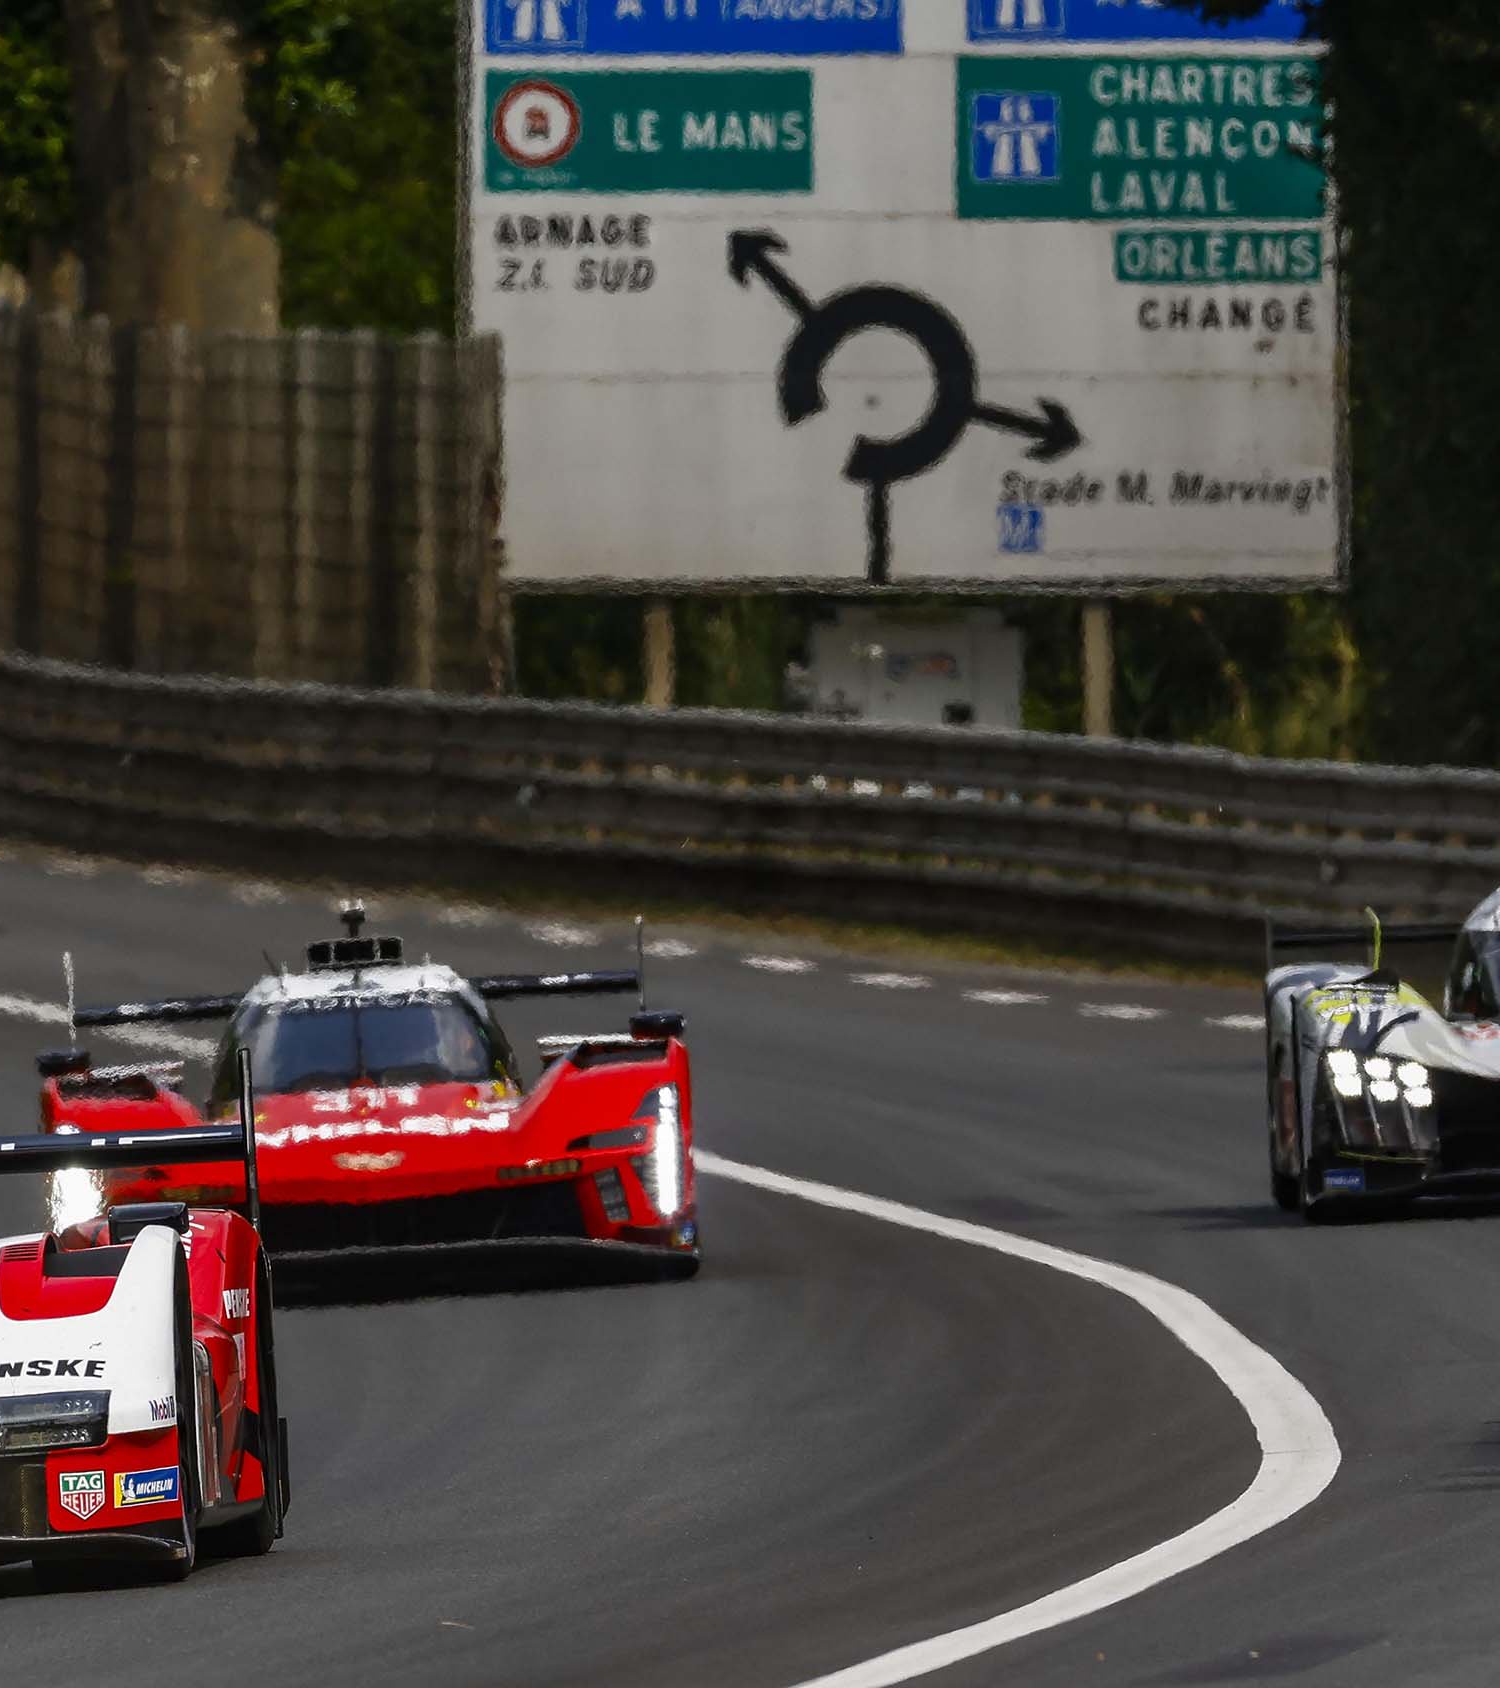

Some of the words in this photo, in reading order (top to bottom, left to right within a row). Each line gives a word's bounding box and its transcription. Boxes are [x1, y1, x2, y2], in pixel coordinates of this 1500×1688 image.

[1090, 62, 1317, 107] CHARTRES
[613, 110, 663, 152] LE
[682, 110, 807, 151] MANS
[1091, 171, 1237, 213] LAVAL
[494, 213, 653, 248] ARNAGE
[574, 257, 656, 294] SUD
[63, 1475, 101, 1491] TAG
[135, 1478, 174, 1496] MICHELIN
[63, 1493, 103, 1515] HEUER
